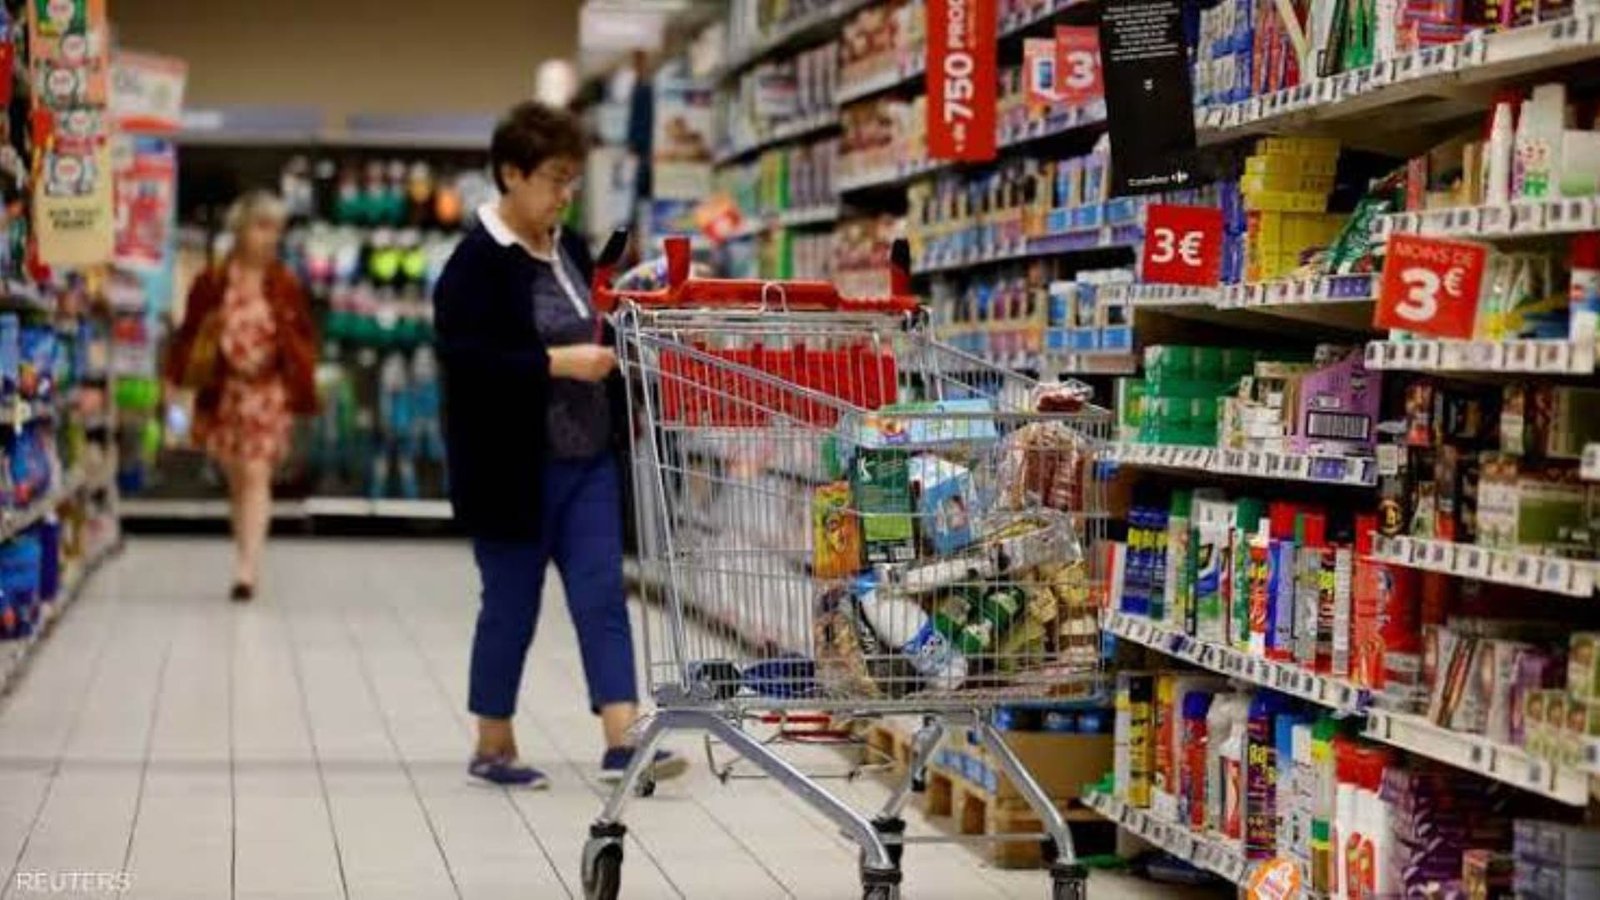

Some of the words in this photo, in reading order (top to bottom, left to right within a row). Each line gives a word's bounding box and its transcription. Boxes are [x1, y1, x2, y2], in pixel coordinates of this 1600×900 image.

[943, 52, 975, 123] 750
[1151, 227, 1204, 266] 3€
[1393, 241, 1450, 265] MOINS
[1452, 247, 1476, 269] DE
